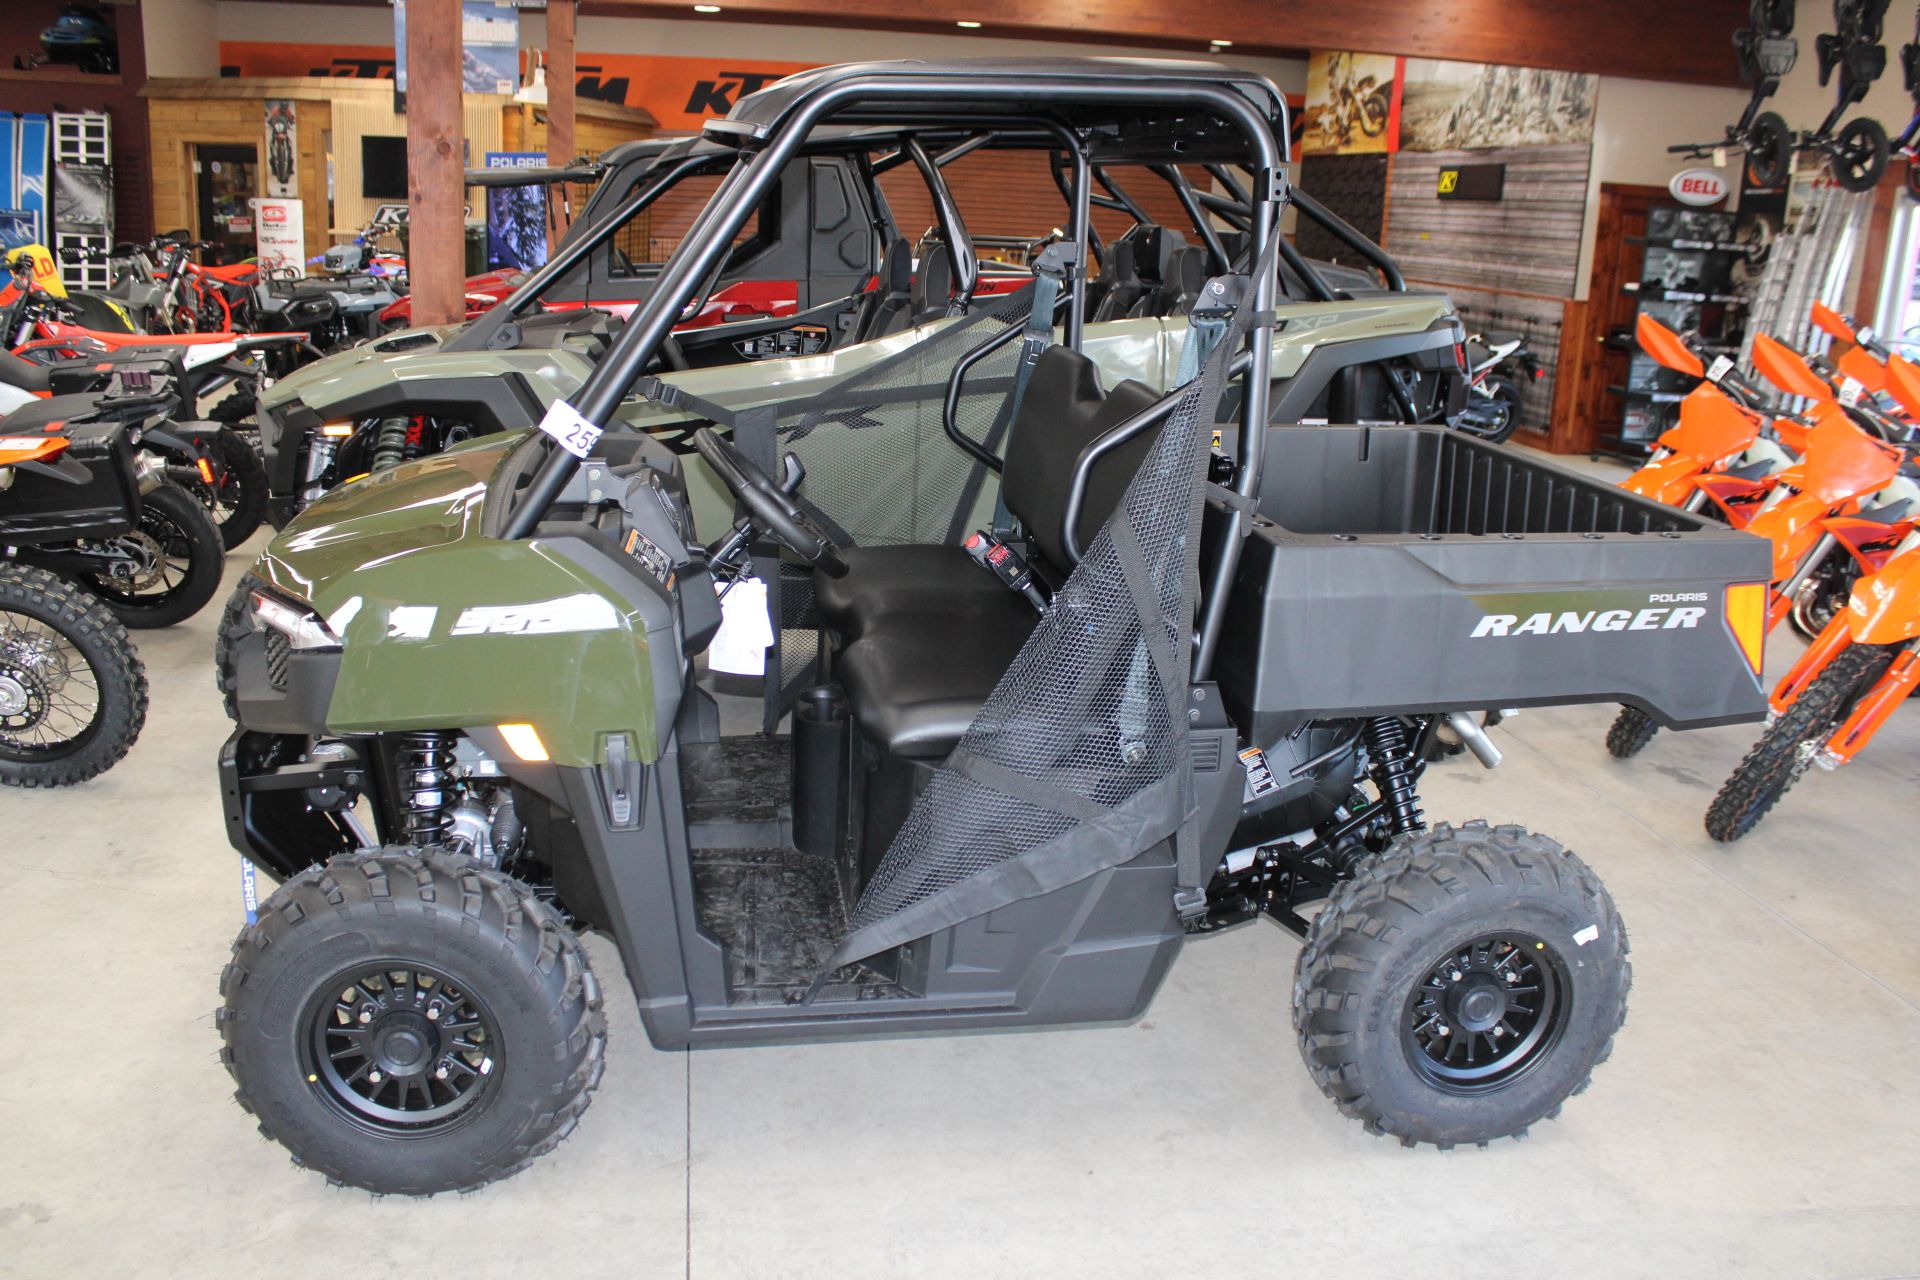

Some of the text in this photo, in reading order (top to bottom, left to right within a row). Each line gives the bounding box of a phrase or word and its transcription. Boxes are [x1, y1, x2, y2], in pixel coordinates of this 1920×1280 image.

[684, 72, 788, 114] KT
[491, 157, 547, 168] POLARIS
[1681, 178, 1720, 196] BELL
[33, 257, 54, 279] LD
[1291, 314, 1339, 331] XP
[1649, 592, 1708, 603] POLARIS
[1470, 606, 1707, 638] RANGER
